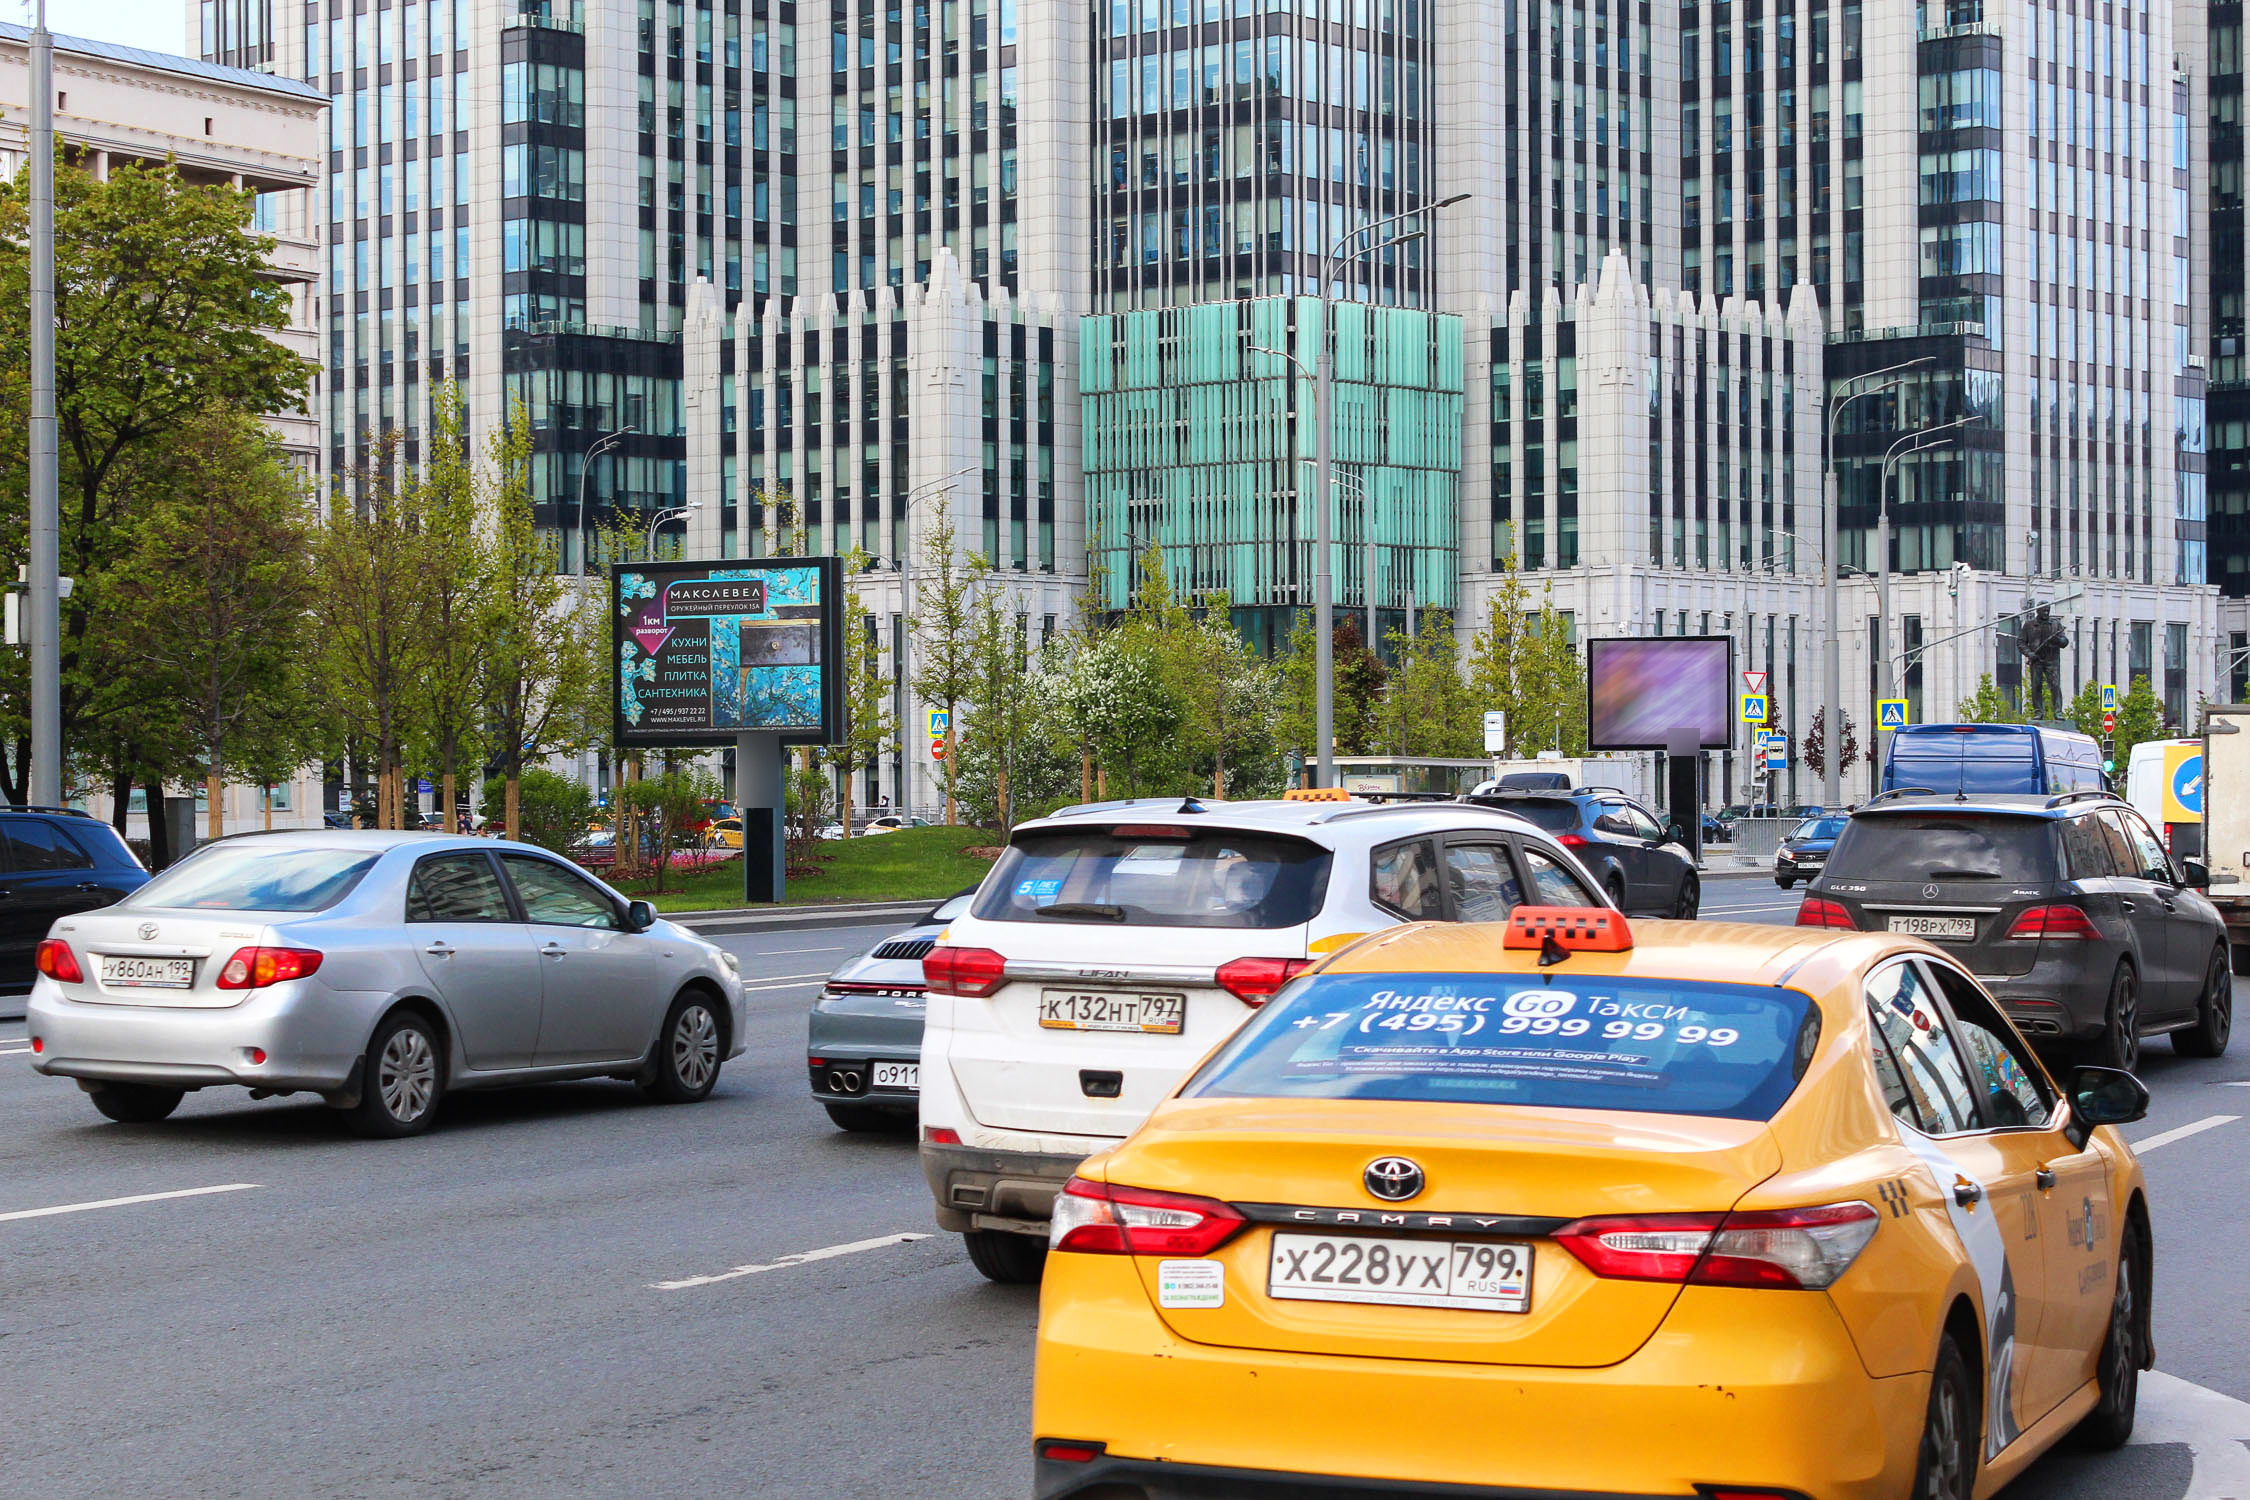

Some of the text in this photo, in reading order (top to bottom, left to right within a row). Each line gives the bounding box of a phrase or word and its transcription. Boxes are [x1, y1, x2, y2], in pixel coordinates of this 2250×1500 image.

[670, 588, 760, 599] МАКСЛЕВЕЛ
[671, 604, 713, 612] ОРУЖЕЙНЫЙ
[643, 616, 660, 625] 1км
[636, 628, 668, 636] разворот
[672, 637, 707, 648] КУХНИ
[667, 655, 707, 664] МЕБЕЛЬ
[664, 672, 707, 681] ПЛИТКА
[638, 688, 707, 699] САНТЕХНИКА
[1018, 881, 1033, 894] 5
[1949, 918, 1971, 930] 799
[168, 961, 188, 975] 199
[1079, 969, 1129, 978] LIFAN
[1142, 997, 1177, 1018] 797
[1363, 991, 1689, 1020] Яндекс Go Такси
[1148, 1017, 1166, 1025] RUS
[1292, 1012, 1739, 1046] +7 (495) 999 99 99
[1354, 1046, 1437, 1054] Скачивайте
[1449, 1047, 1480, 1056] App
[1481, 1048, 1522, 1056] Store
[1522, 1050, 1551, 1058] или
[1553, 1050, 1606, 1061] Google
[1607, 1053, 1640, 1063] Play
[1294, 1210, 1500, 1227] CAMRY
[1455, 1246, 1517, 1280] 799
[1467, 1281, 1498, 1292] RUS
